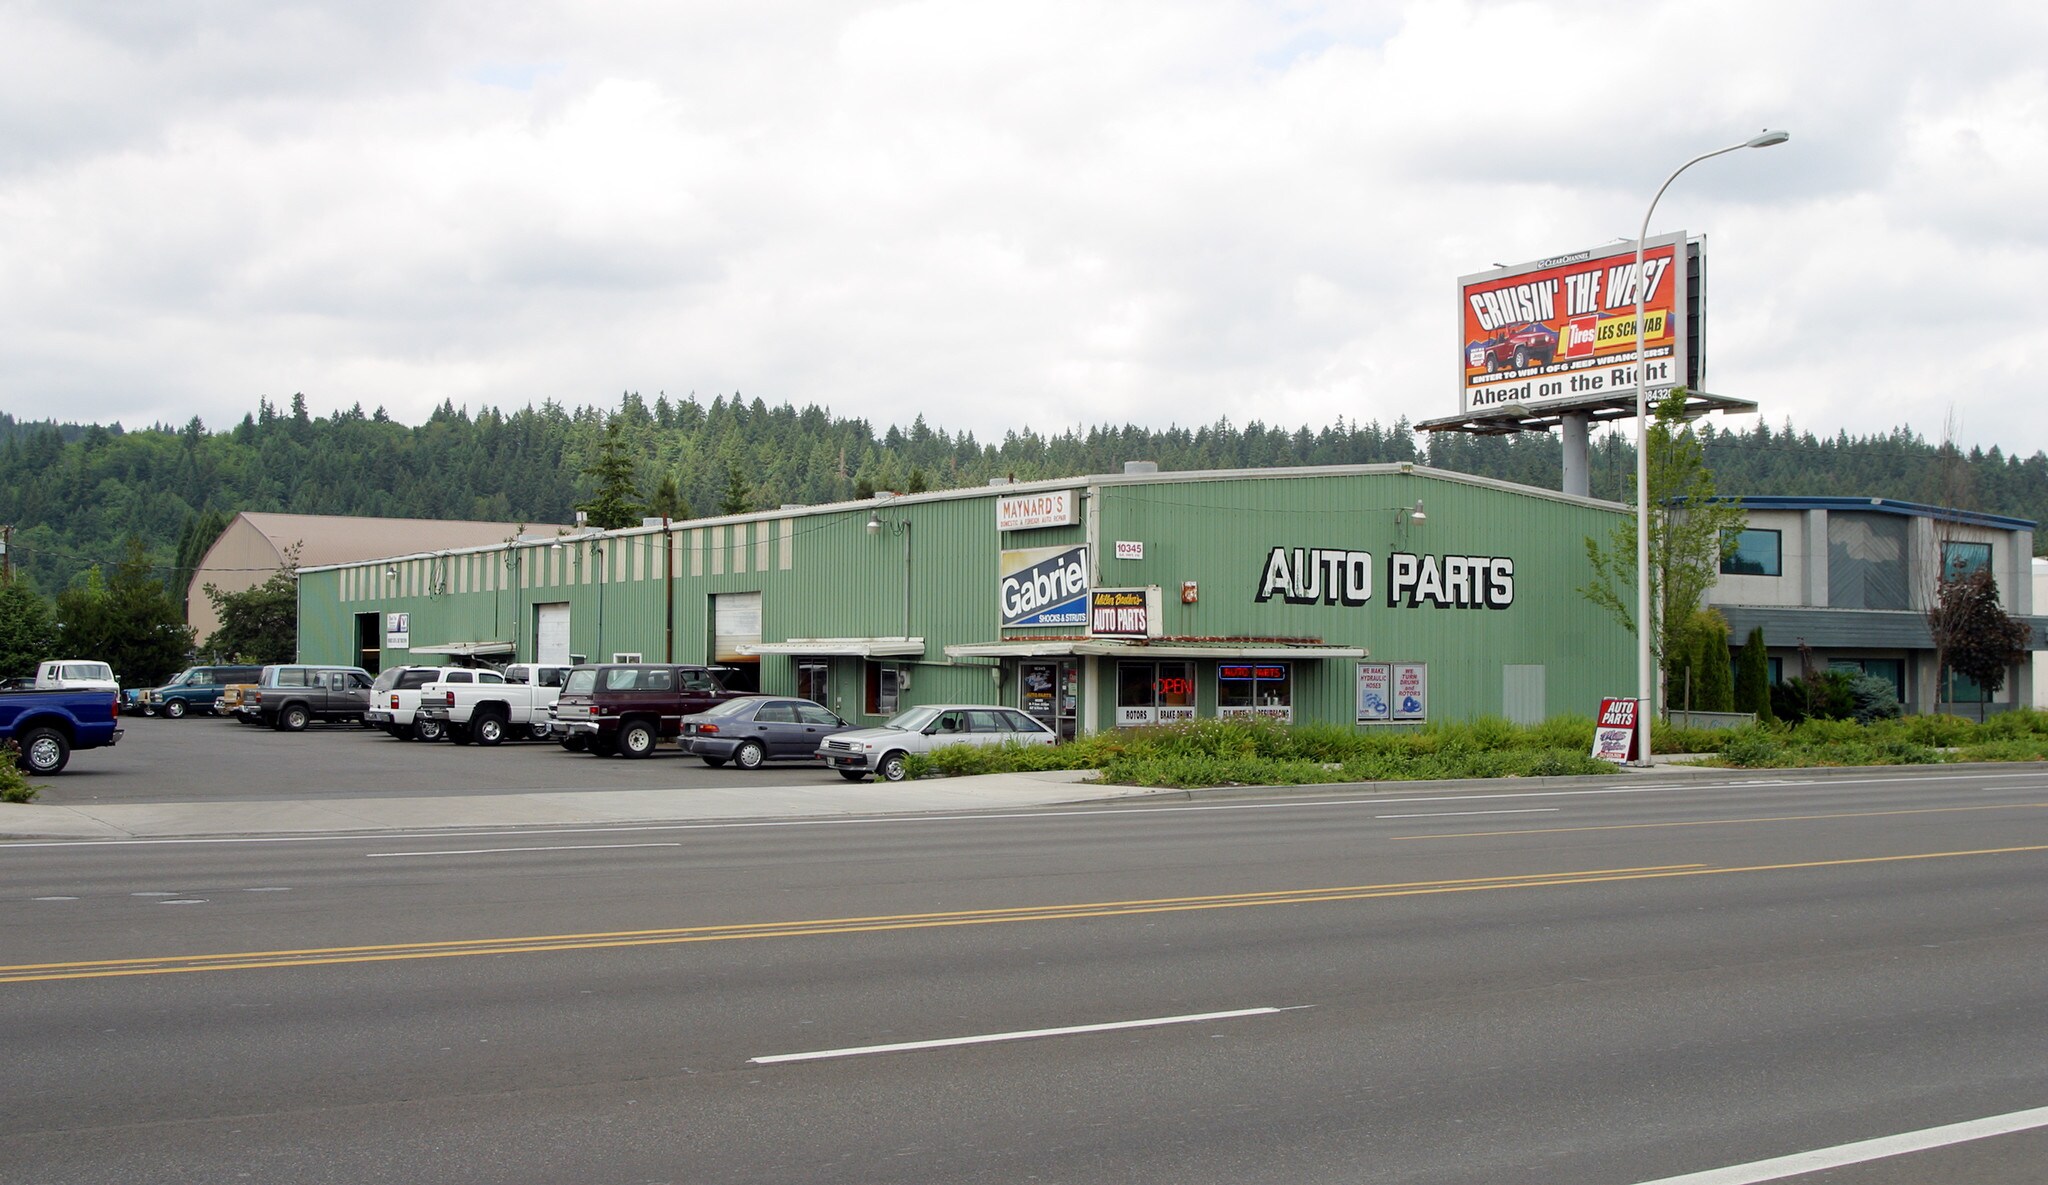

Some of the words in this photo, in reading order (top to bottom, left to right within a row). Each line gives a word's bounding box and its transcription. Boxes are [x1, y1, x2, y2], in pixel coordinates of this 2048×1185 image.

[1469, 278, 1559, 331] CRUISIN'
[1564, 270, 1602, 316] THE
[1570, 324, 1595, 348] Tires
[1597, 325, 1614, 341] LES
[1617, 317, 1662, 338] SCHAB
[1472, 373, 1502, 384] ENTER
[1504, 371, 1517, 380] TO
[1519, 367, 1538, 378] WIN
[1570, 359, 1595, 370] JEEP
[1597, 347, 1670, 365] WRANGERS!
[1472, 382, 1531, 406] Ahead
[1539, 381, 1562, 397] on
[1570, 374, 1603, 393] the
[1003, 496, 1063, 519] MAYNARD'S
[1117, 544, 1142, 553] 10345
[1002, 549, 1088, 618] Gabriel
[1255, 547, 1372, 606] AUTO
[1387, 552, 1514, 610] PARTS
[1039, 614, 1060, 623] SHOCKS
[1061, 614, 1065, 622] &
[1066, 613, 1086, 622] STRUTS
[1094, 608, 1116, 631] AUTO
[1117, 608, 1146, 631] PARTS
[1223, 668, 1250, 677] AUTO
[1153, 678, 1193, 694] OPEN
[1126, 710, 1147, 720] ROTORS
[1160, 710, 1175, 720] BRAKE
[1608, 701, 1634, 713] AUTO
[1601, 713, 1634, 725] PARTS
